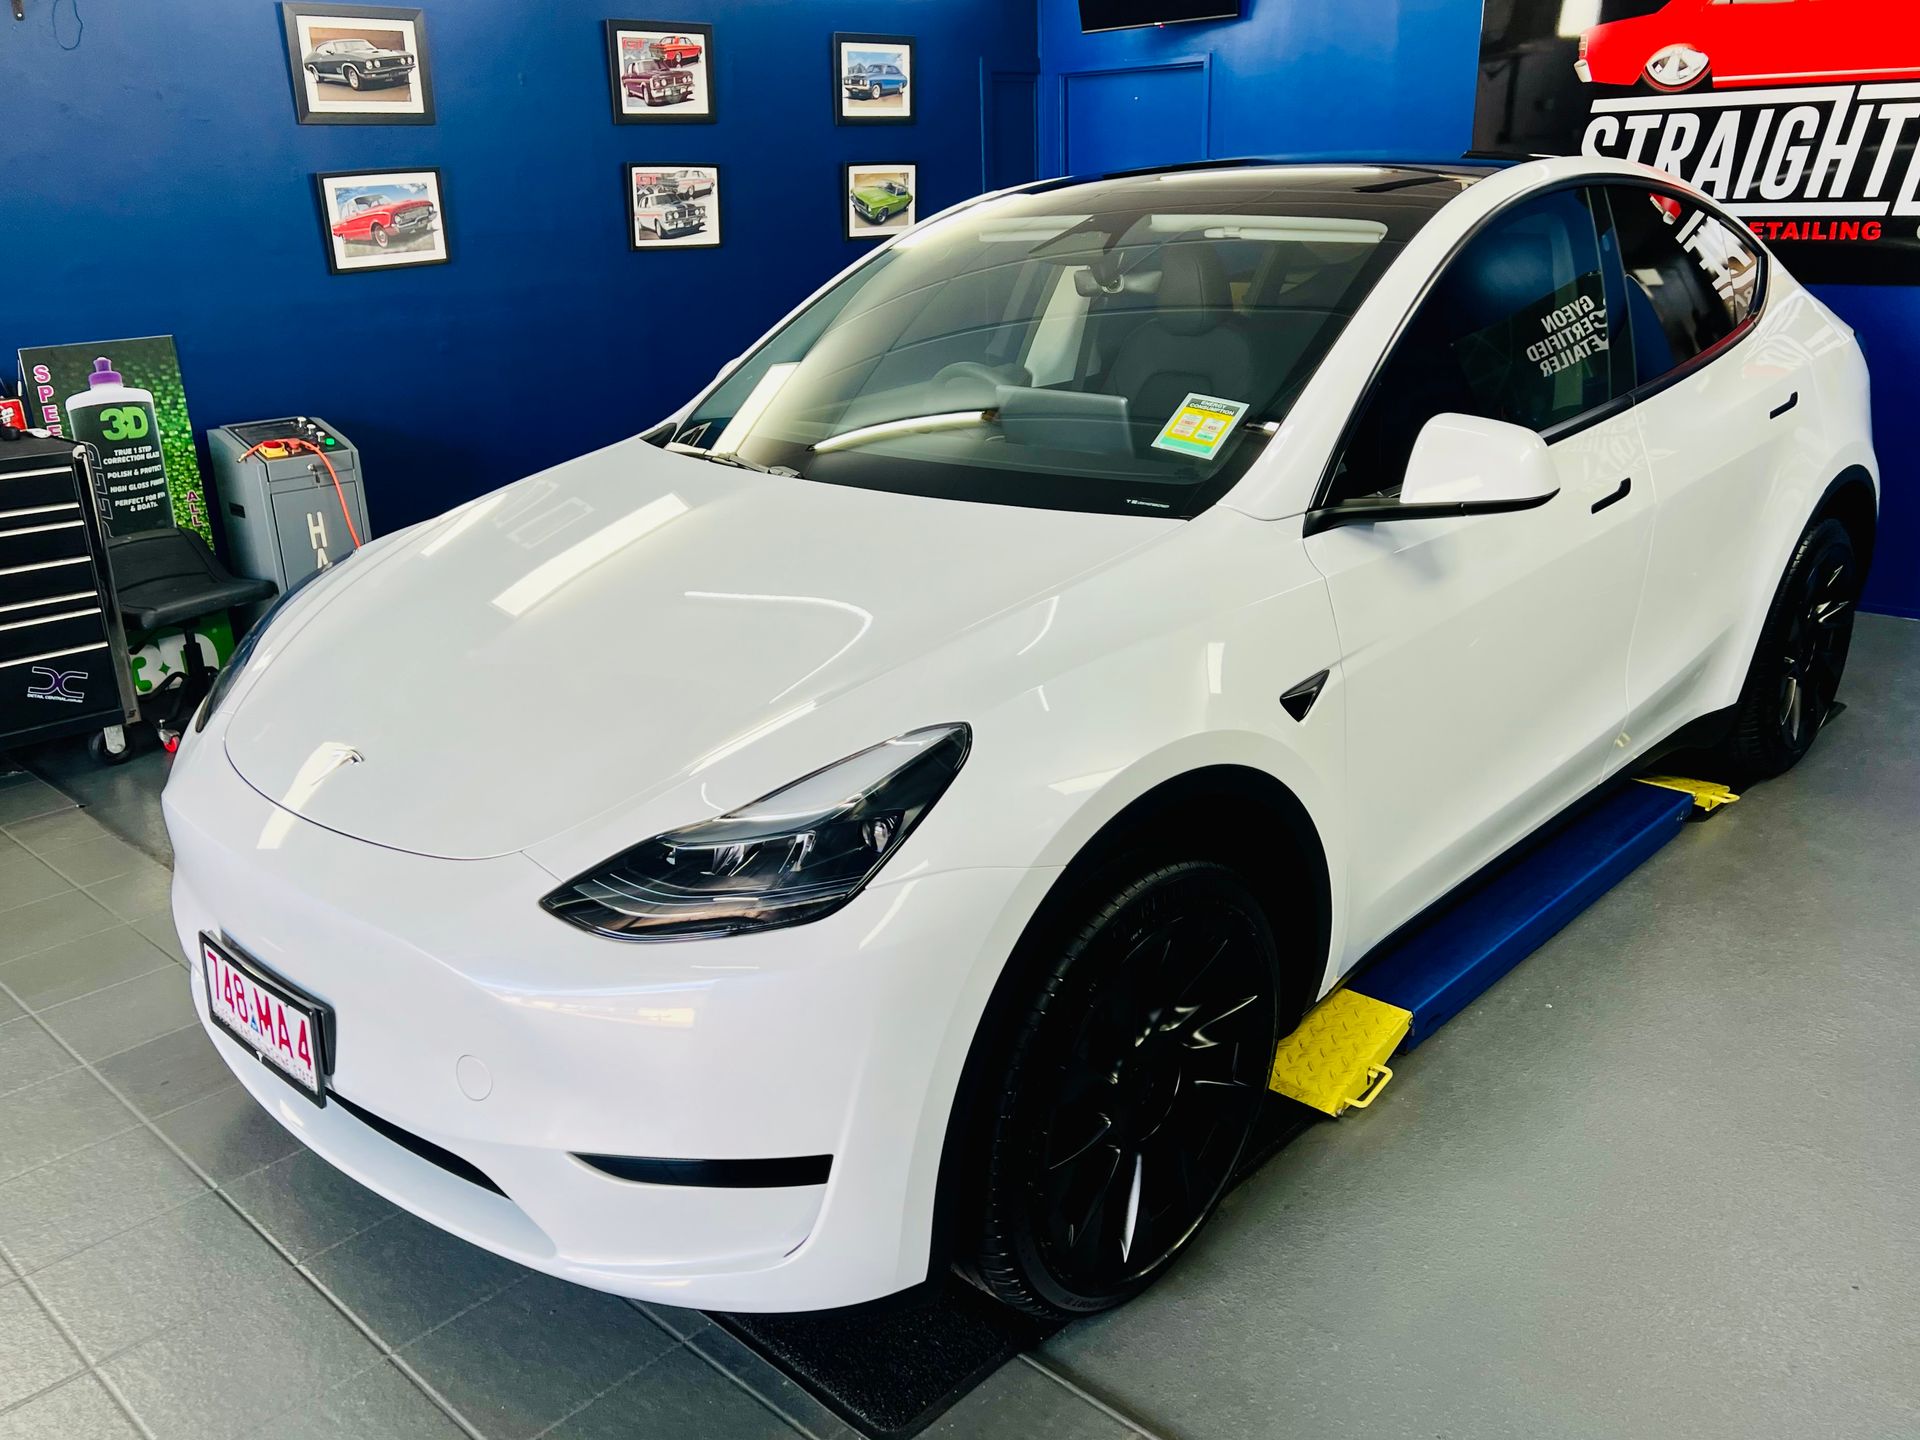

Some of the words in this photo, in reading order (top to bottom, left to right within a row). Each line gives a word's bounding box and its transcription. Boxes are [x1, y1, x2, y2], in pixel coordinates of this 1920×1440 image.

[1581, 86, 1920, 216] STRAIGHT
[1748, 221, 1882, 241] ETAILING
[100, 406, 149, 441] 3D
[107, 469, 133, 479] POLISH
[128, 481, 150, 491] GLOSS
[114, 496, 145, 507] PERFECT
